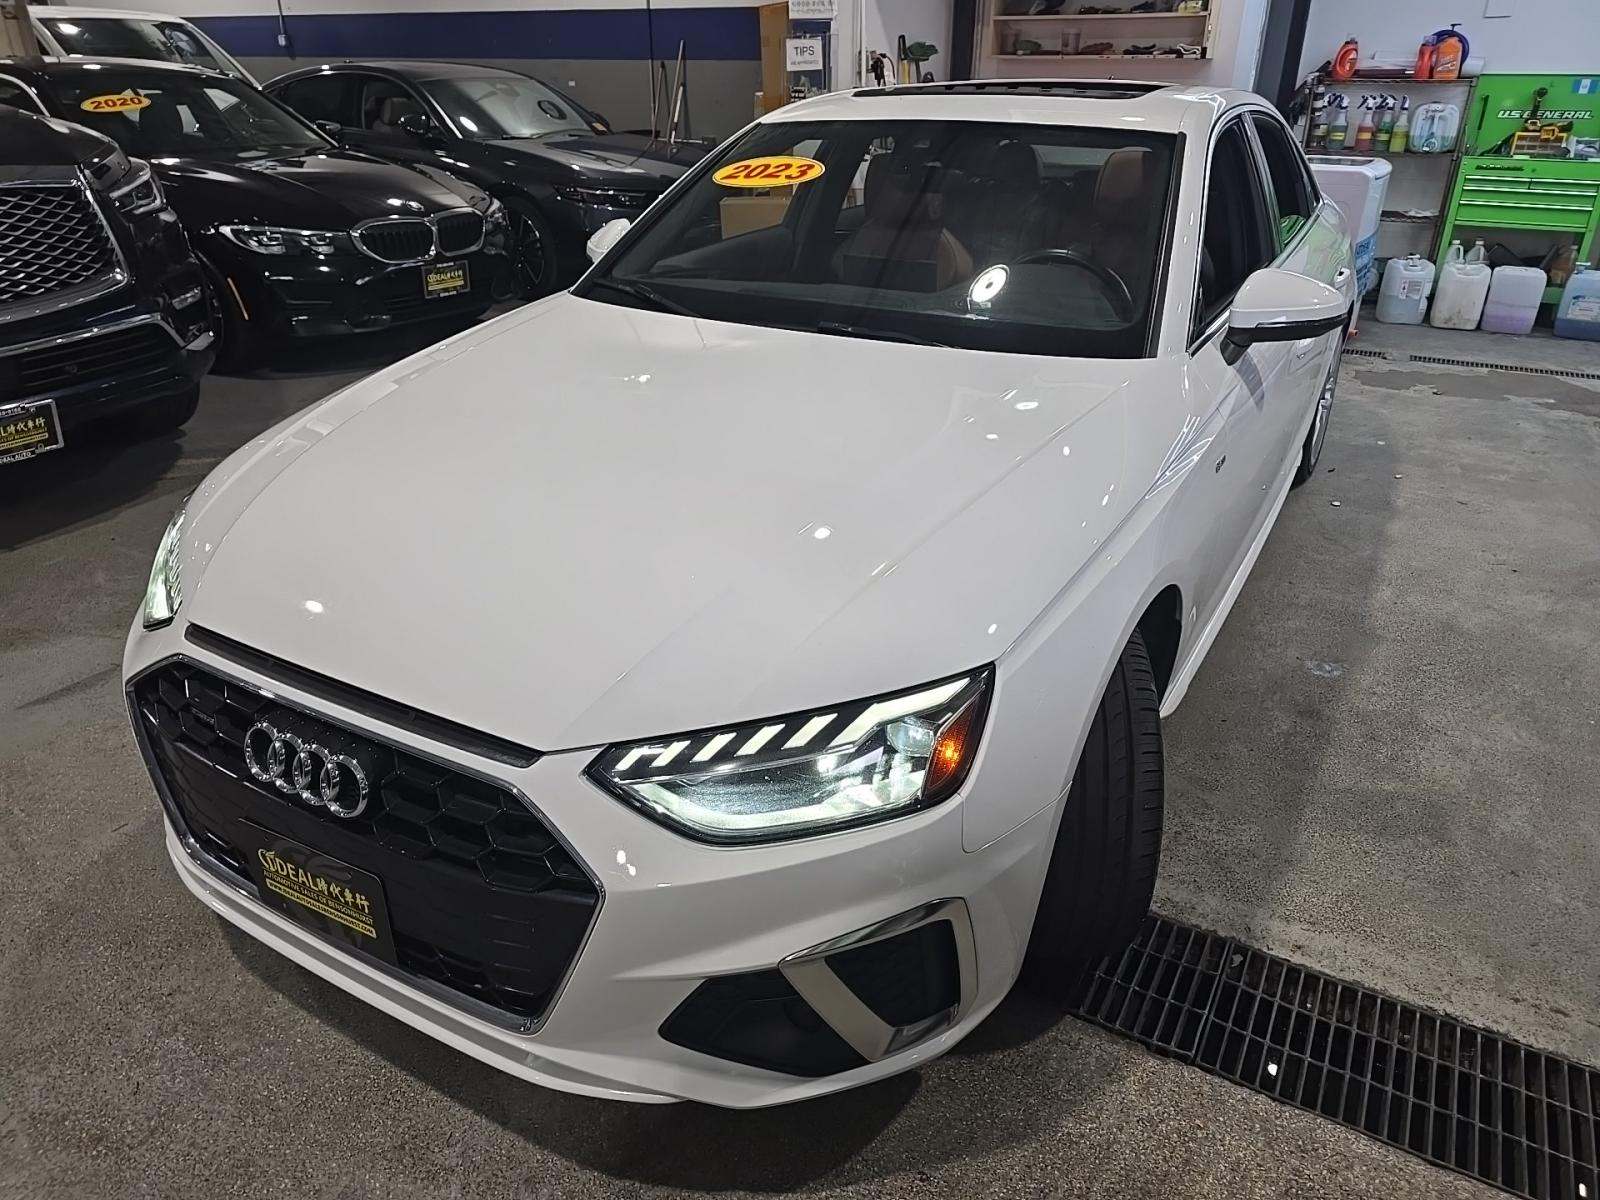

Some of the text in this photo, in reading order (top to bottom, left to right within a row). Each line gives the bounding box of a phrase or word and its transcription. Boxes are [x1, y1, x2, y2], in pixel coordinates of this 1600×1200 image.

[793, 46, 815, 57] TIPS
[90, 97, 142, 110] 2020
[719, 163, 816, 181] 2023
